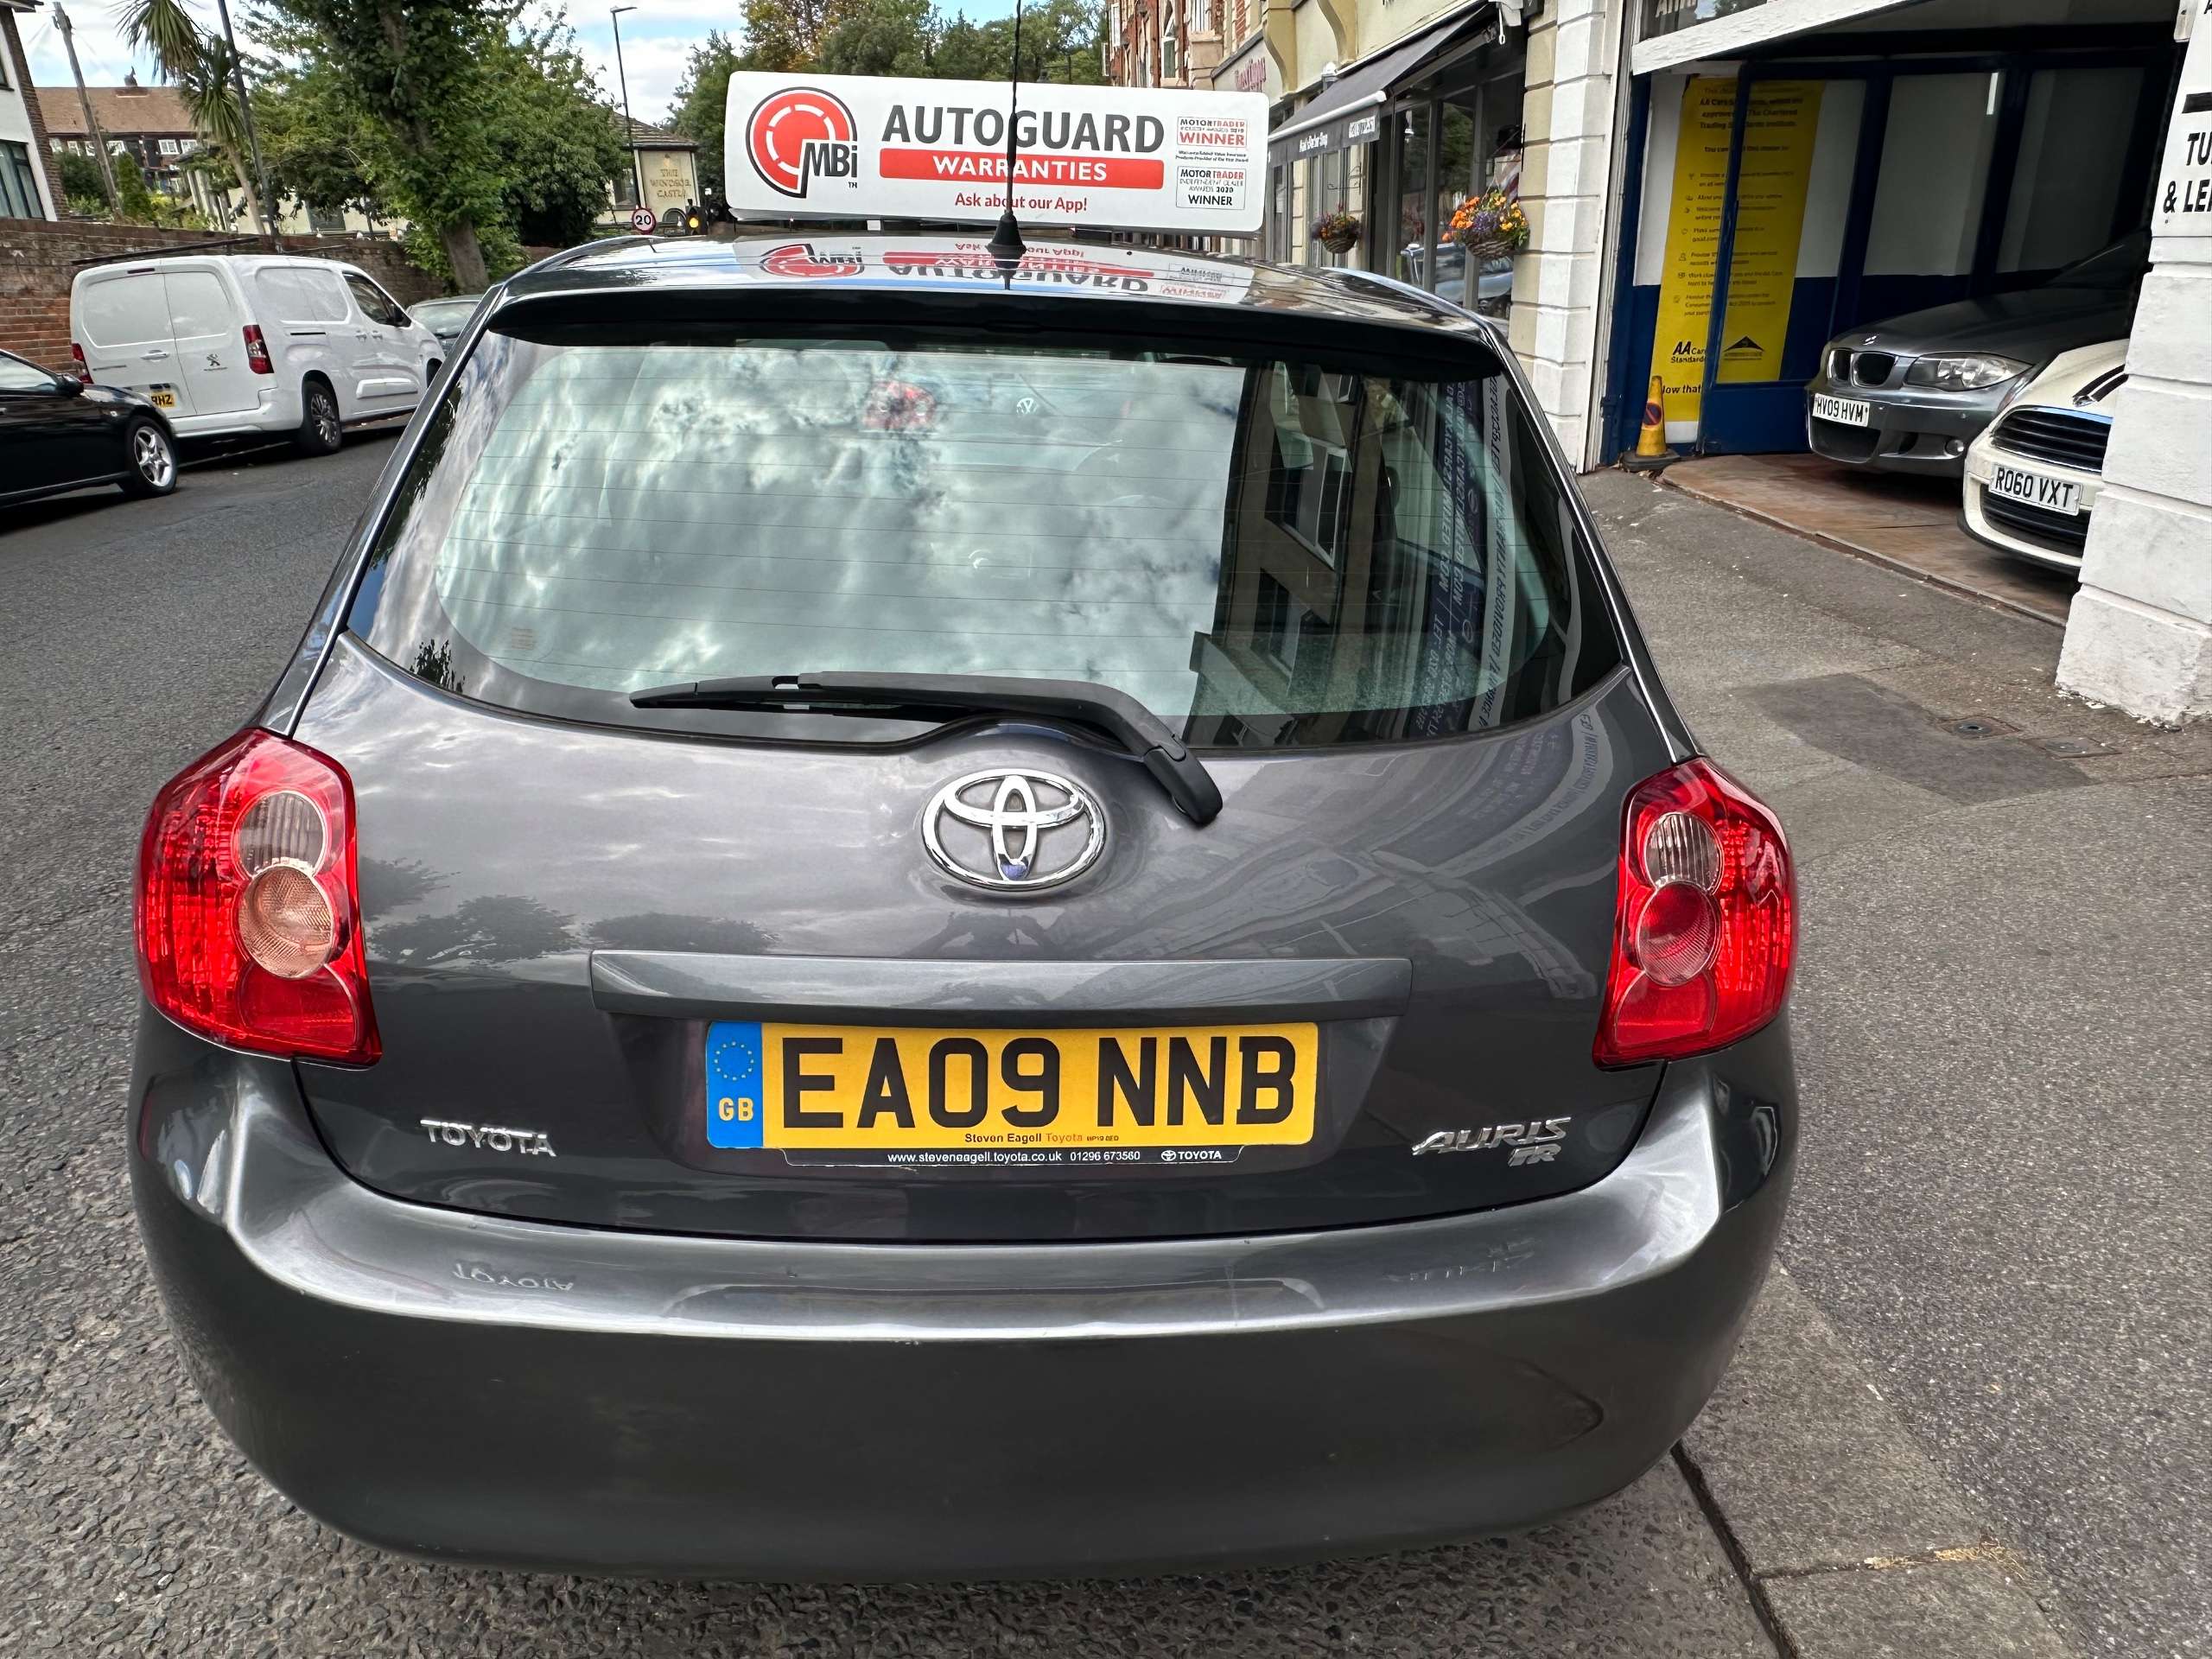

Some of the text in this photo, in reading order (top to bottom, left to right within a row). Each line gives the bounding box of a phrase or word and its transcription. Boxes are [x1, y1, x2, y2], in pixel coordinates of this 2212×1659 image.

[881, 105, 1164, 153] AUTOGUARD
[1179, 131, 1244, 145] WINNER
[803, 142, 858, 178] MBi
[2186, 132, 2212, 166] TU
[932, 156, 1107, 181] WARRANTIES
[955, 192, 1087, 213] Ask about our App!
[1188, 194, 1232, 206] WINNER
[2183, 179, 2212, 213] LE
[635, 214, 652, 226] 20
[1673, 341, 1692, 355] AA
[1682, 385, 1701, 394] that
[1816, 397, 1864, 423] HV09 HVM
[1995, 467, 2074, 507] RO60 VXT
[782, 1035, 1297, 1128] EA09 NNB
[719, 1096, 754, 1122] GB
[420, 1118, 557, 1157] TOYOTA
[964, 1133, 1004, 1142] Steven
[1007, 1133, 1041, 1145] Eagell
[1045, 1133, 1083, 1145] Toyota
[1412, 1116, 1572, 1156] AURIS
[887, 1152, 1062, 1164] www.steveneagell.toyota.co.uk
[1070, 1151, 1101, 1161] 01296
[1178, 1150, 1222, 1160] TOYOTA
